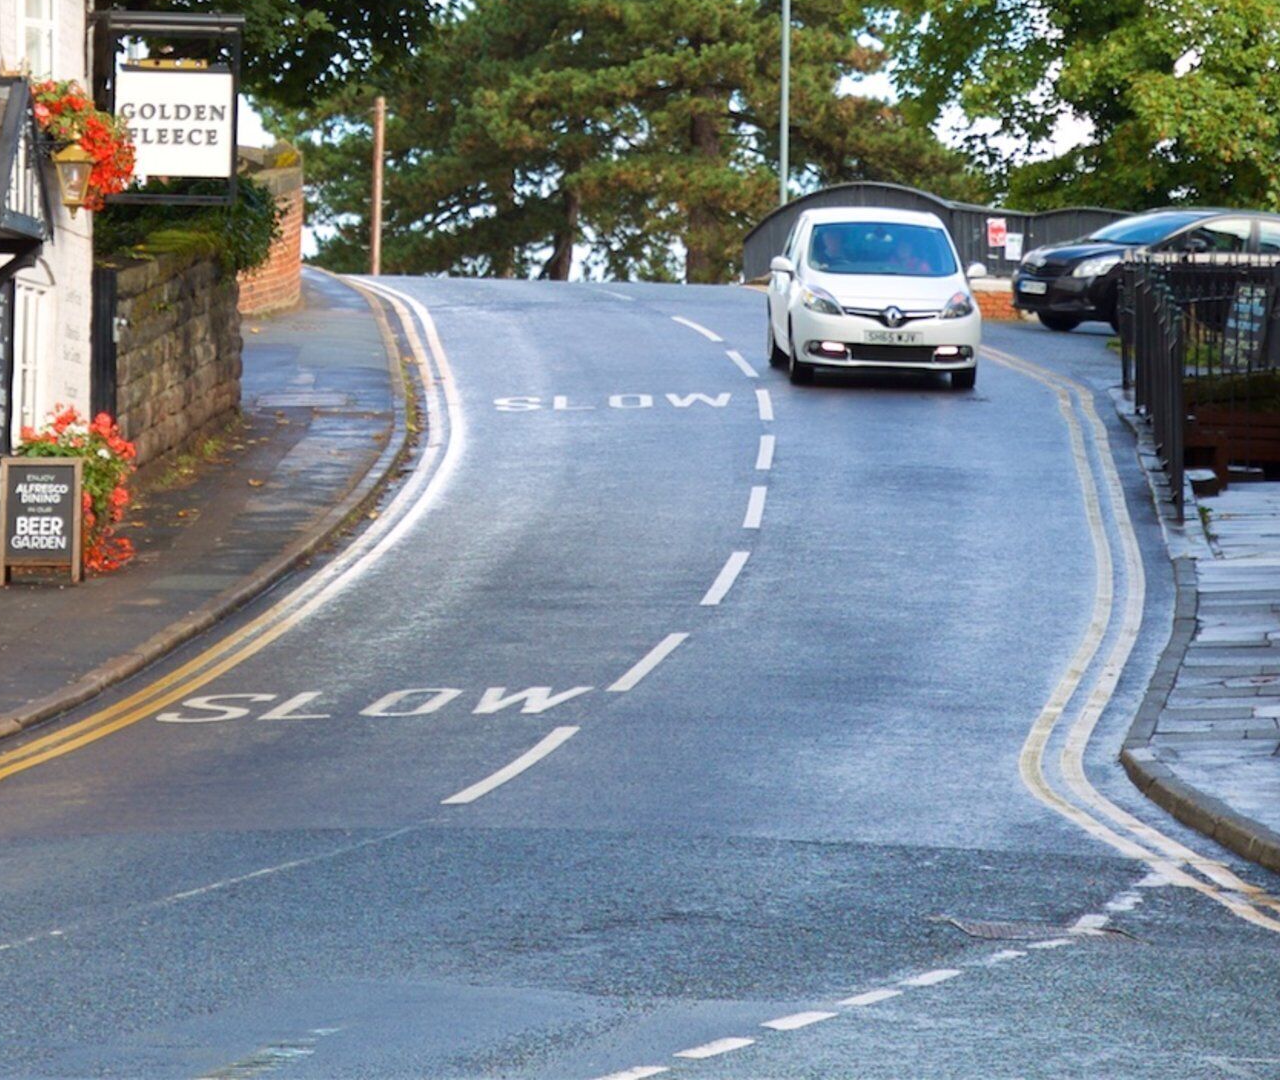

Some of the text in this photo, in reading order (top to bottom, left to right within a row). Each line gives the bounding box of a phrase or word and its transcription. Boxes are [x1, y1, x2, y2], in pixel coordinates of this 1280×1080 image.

[120, 103, 227, 121] GOLDEN
[127, 128, 219, 146] FLEECE
[493, 392, 731, 413] SLOW
[26, 474, 56, 482] ENJOY
[15, 483, 69, 494] ALFRESCO
[21, 494, 61, 504] DINING
[16, 517, 63, 536] BEER
[11, 536, 66, 550] GARDEN
[156, 685, 595, 722] SLOW
